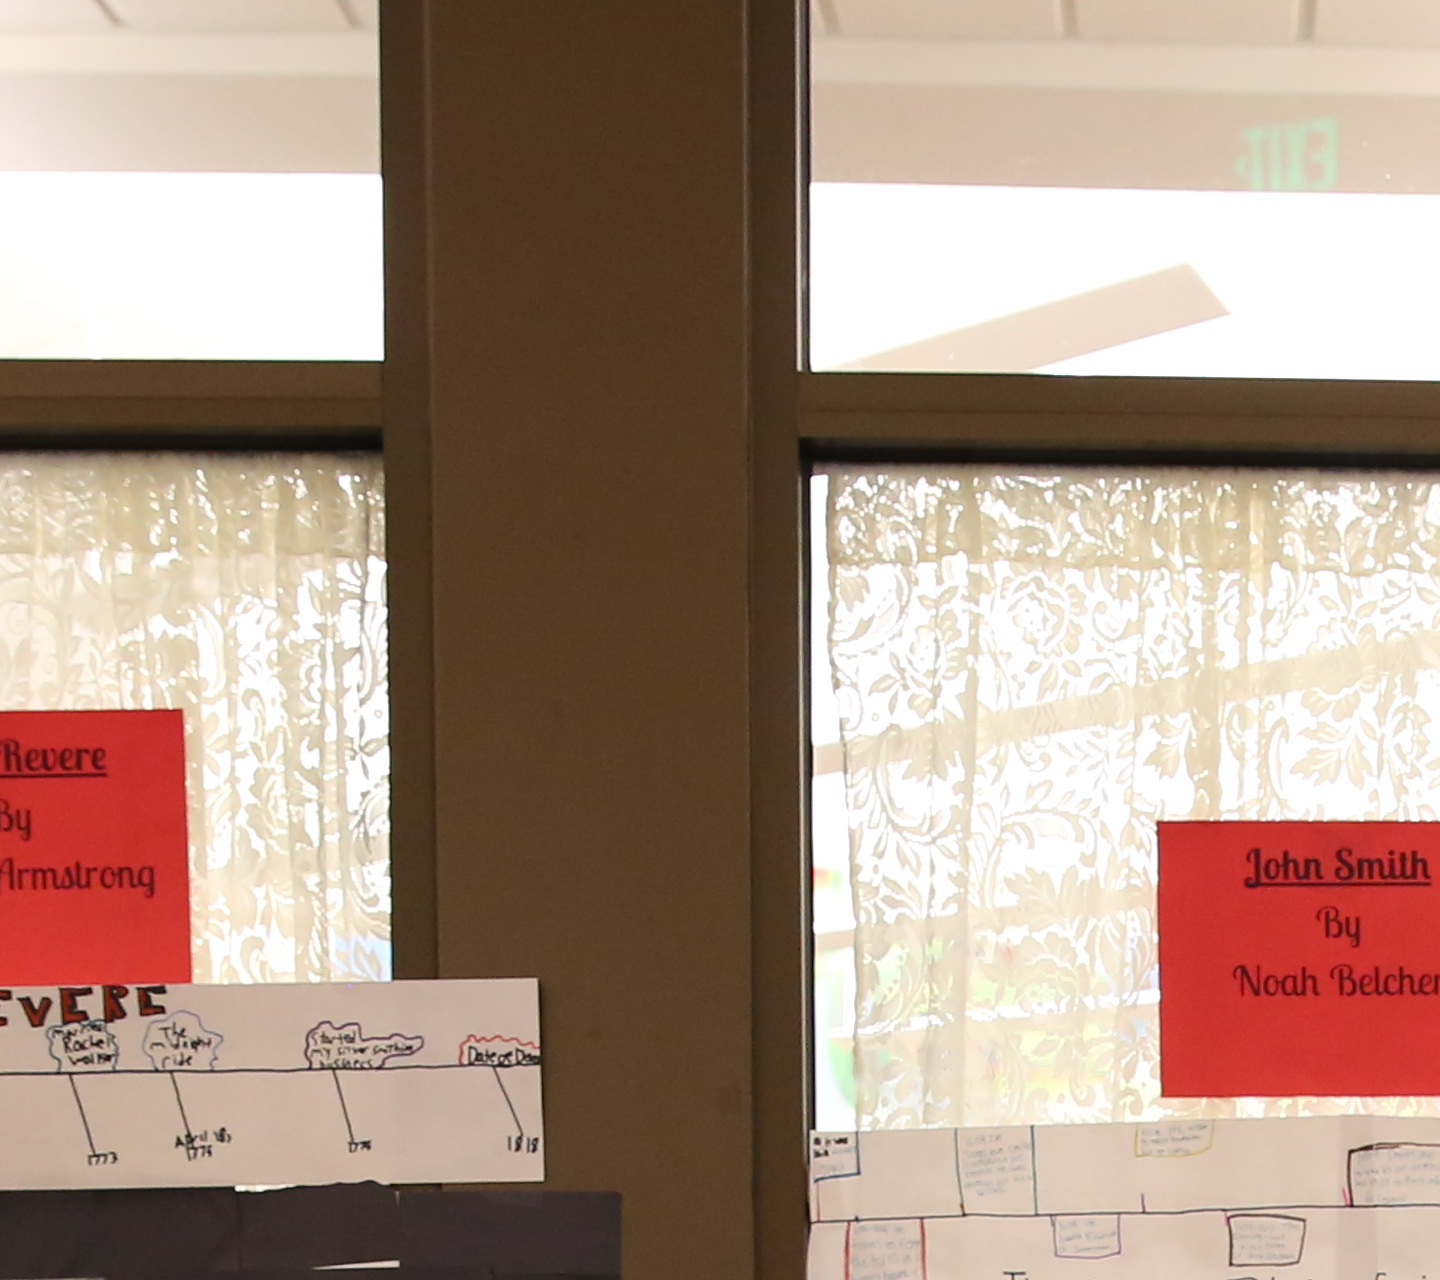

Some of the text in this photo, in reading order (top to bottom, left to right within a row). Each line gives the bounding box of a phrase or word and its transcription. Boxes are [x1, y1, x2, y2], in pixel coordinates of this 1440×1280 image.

[1244, 846, 1433, 889] John Smith
[1315, 905, 1361, 949] By
[1232, 963, 1321, 998] Noah
